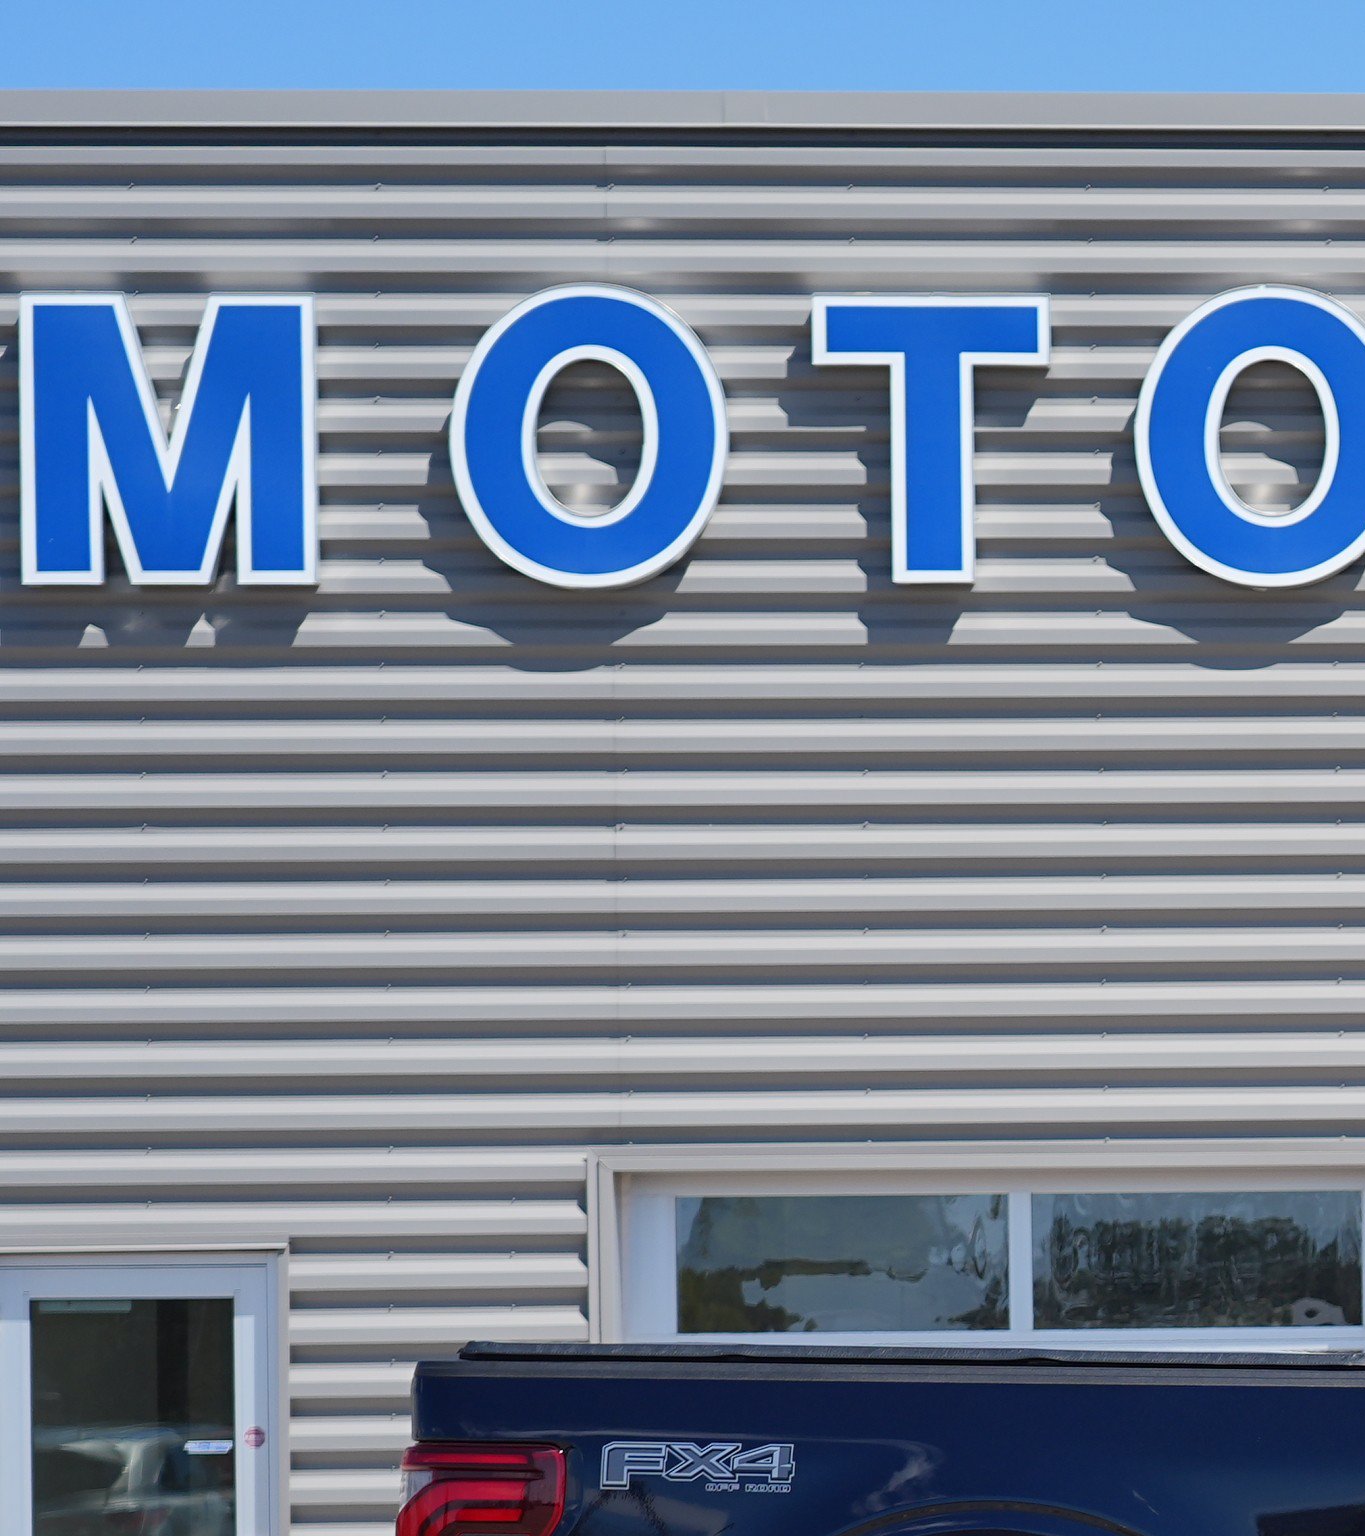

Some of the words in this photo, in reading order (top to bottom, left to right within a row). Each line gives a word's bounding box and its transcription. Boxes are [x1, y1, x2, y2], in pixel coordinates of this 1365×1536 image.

[600, 1441, 796, 1490] FX4
[705, 1483, 740, 1493] OFF
[745, 1483, 792, 1493] ROAD
